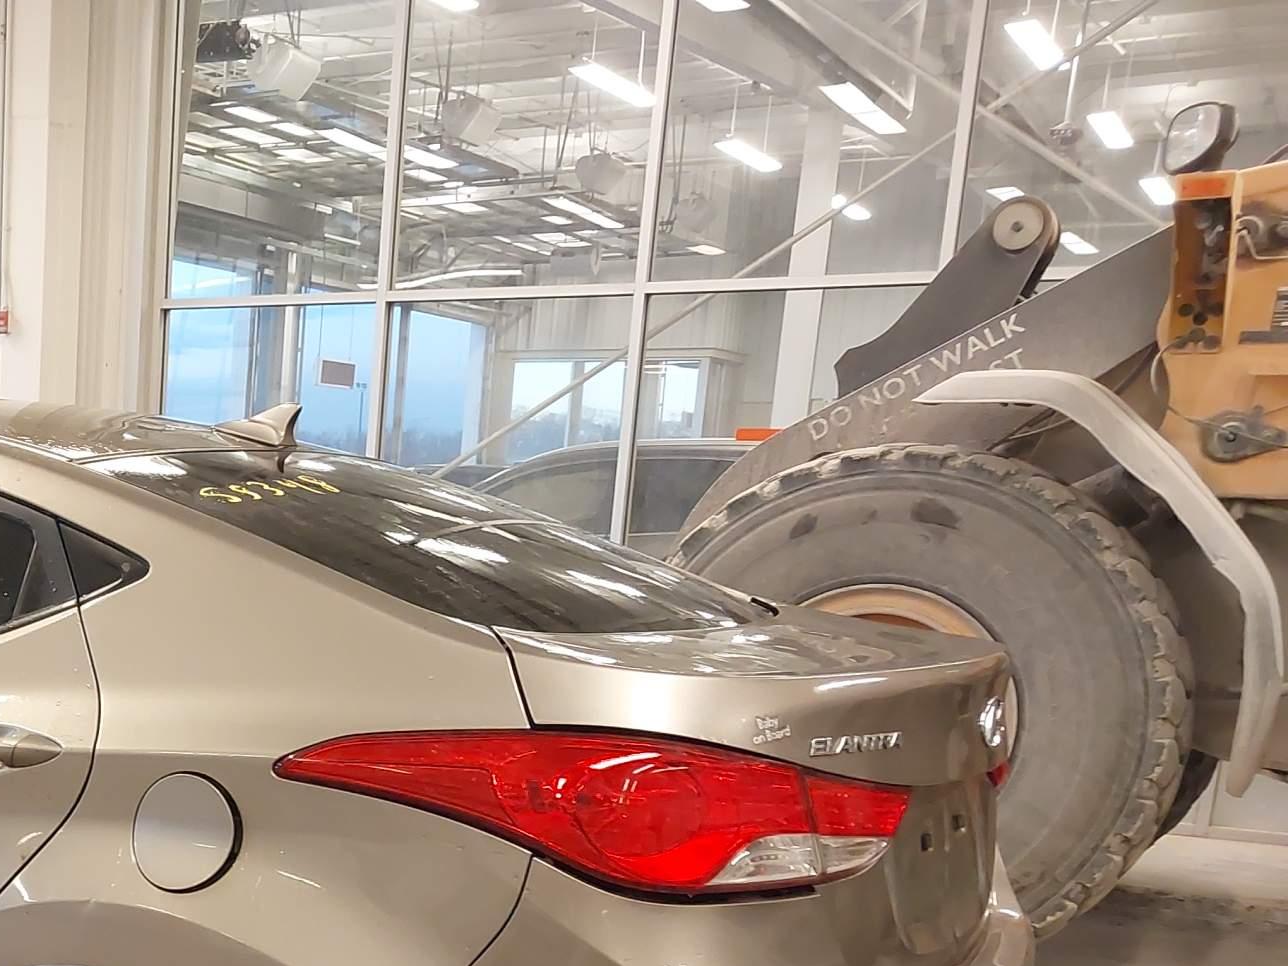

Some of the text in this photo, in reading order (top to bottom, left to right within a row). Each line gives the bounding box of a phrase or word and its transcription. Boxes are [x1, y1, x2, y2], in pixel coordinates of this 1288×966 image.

[807, 406, 852, 441] DO
[859, 364, 922, 407] NOT
[930, 313, 1026, 372] WALK
[809, 731, 903, 757] ELANTRA
